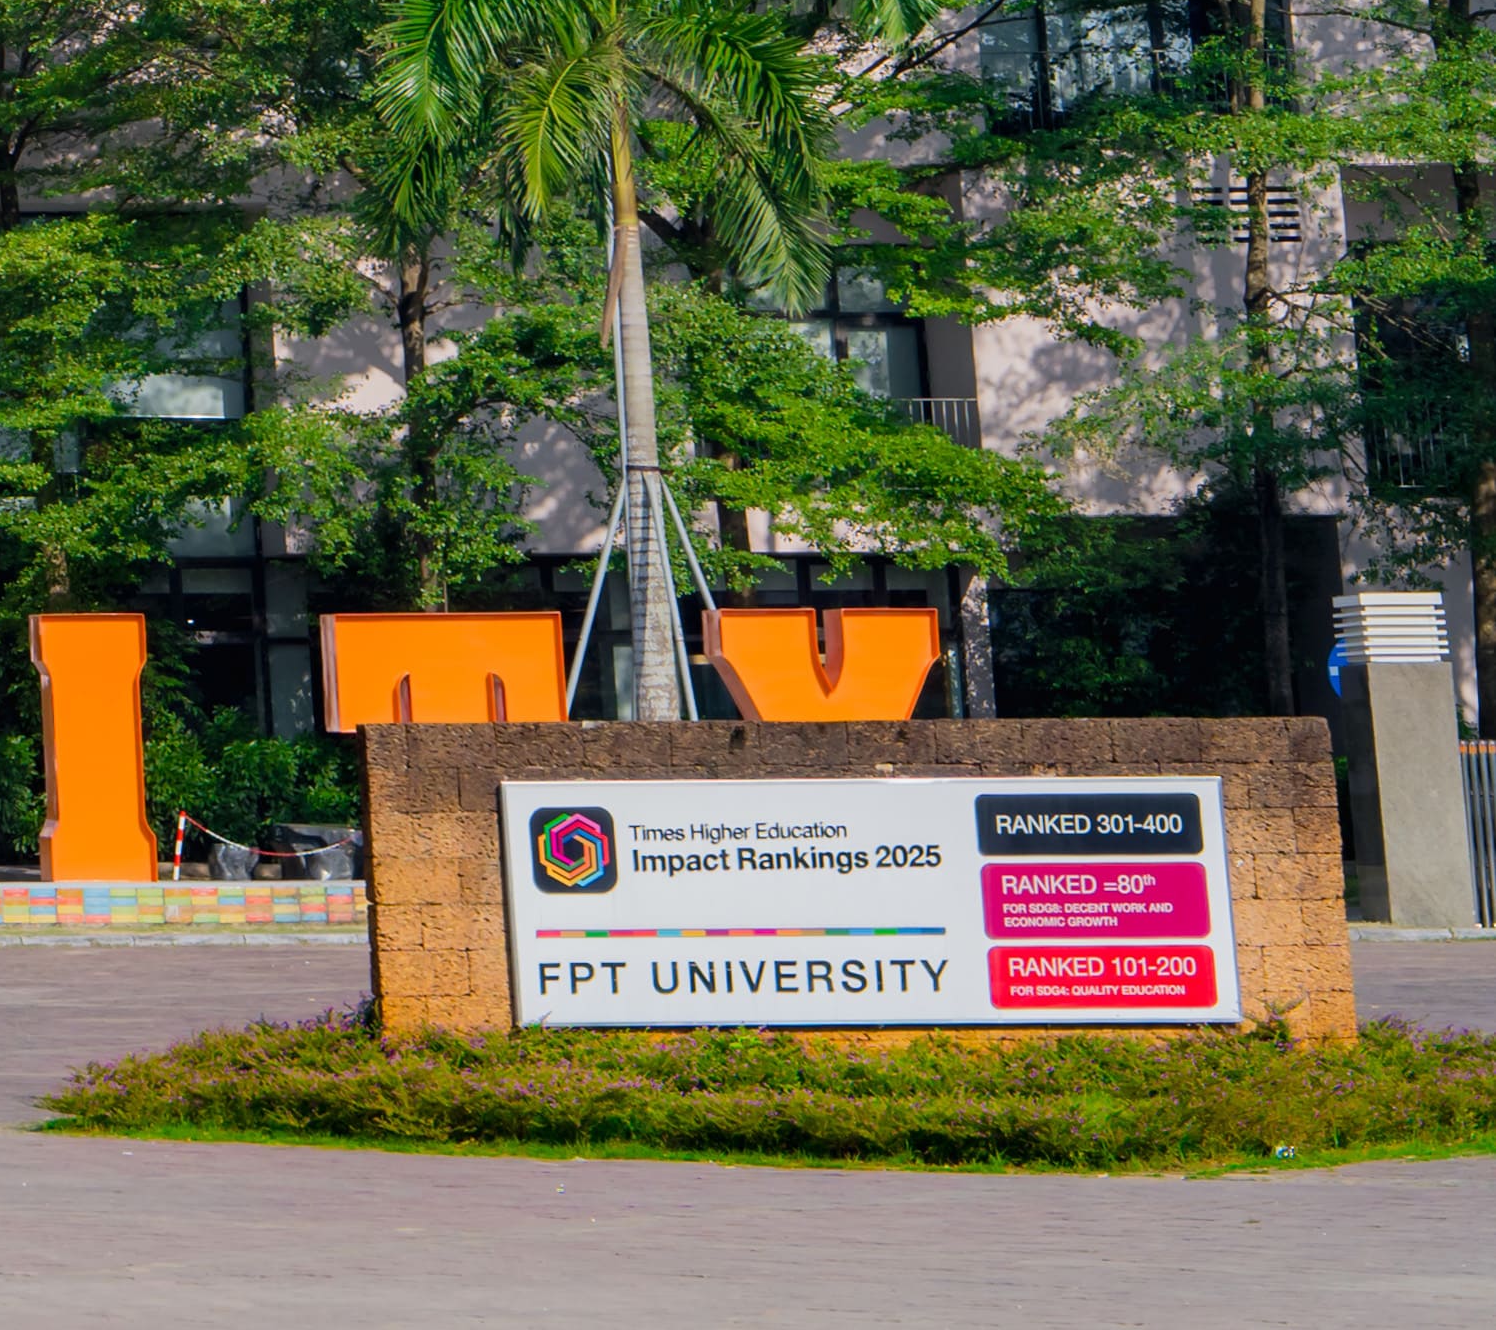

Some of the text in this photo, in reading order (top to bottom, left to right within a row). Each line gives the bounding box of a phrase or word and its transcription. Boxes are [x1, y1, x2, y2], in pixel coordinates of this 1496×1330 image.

[629, 821, 848, 844] Times Higher Education
[995, 813, 1183, 835] RANKED 301-400
[632, 845, 942, 877] Impact Rankings 2025
[1001, 874, 1097, 895] RANKED
[1003, 903, 1026, 914] FOR
[1064, 903, 1110, 914] DECENT
[1111, 902, 1147, 914] WORK
[1149, 902, 1173, 913] AND
[1004, 916, 1118, 928] ECONOMIC GROWTH
[539, 958, 949, 996] FPT UNIVERSITY
[1008, 956, 1197, 978] RANKED 101-200
[1010, 985, 1186, 997] FOR SDG4: QUALITY EDUCATION
